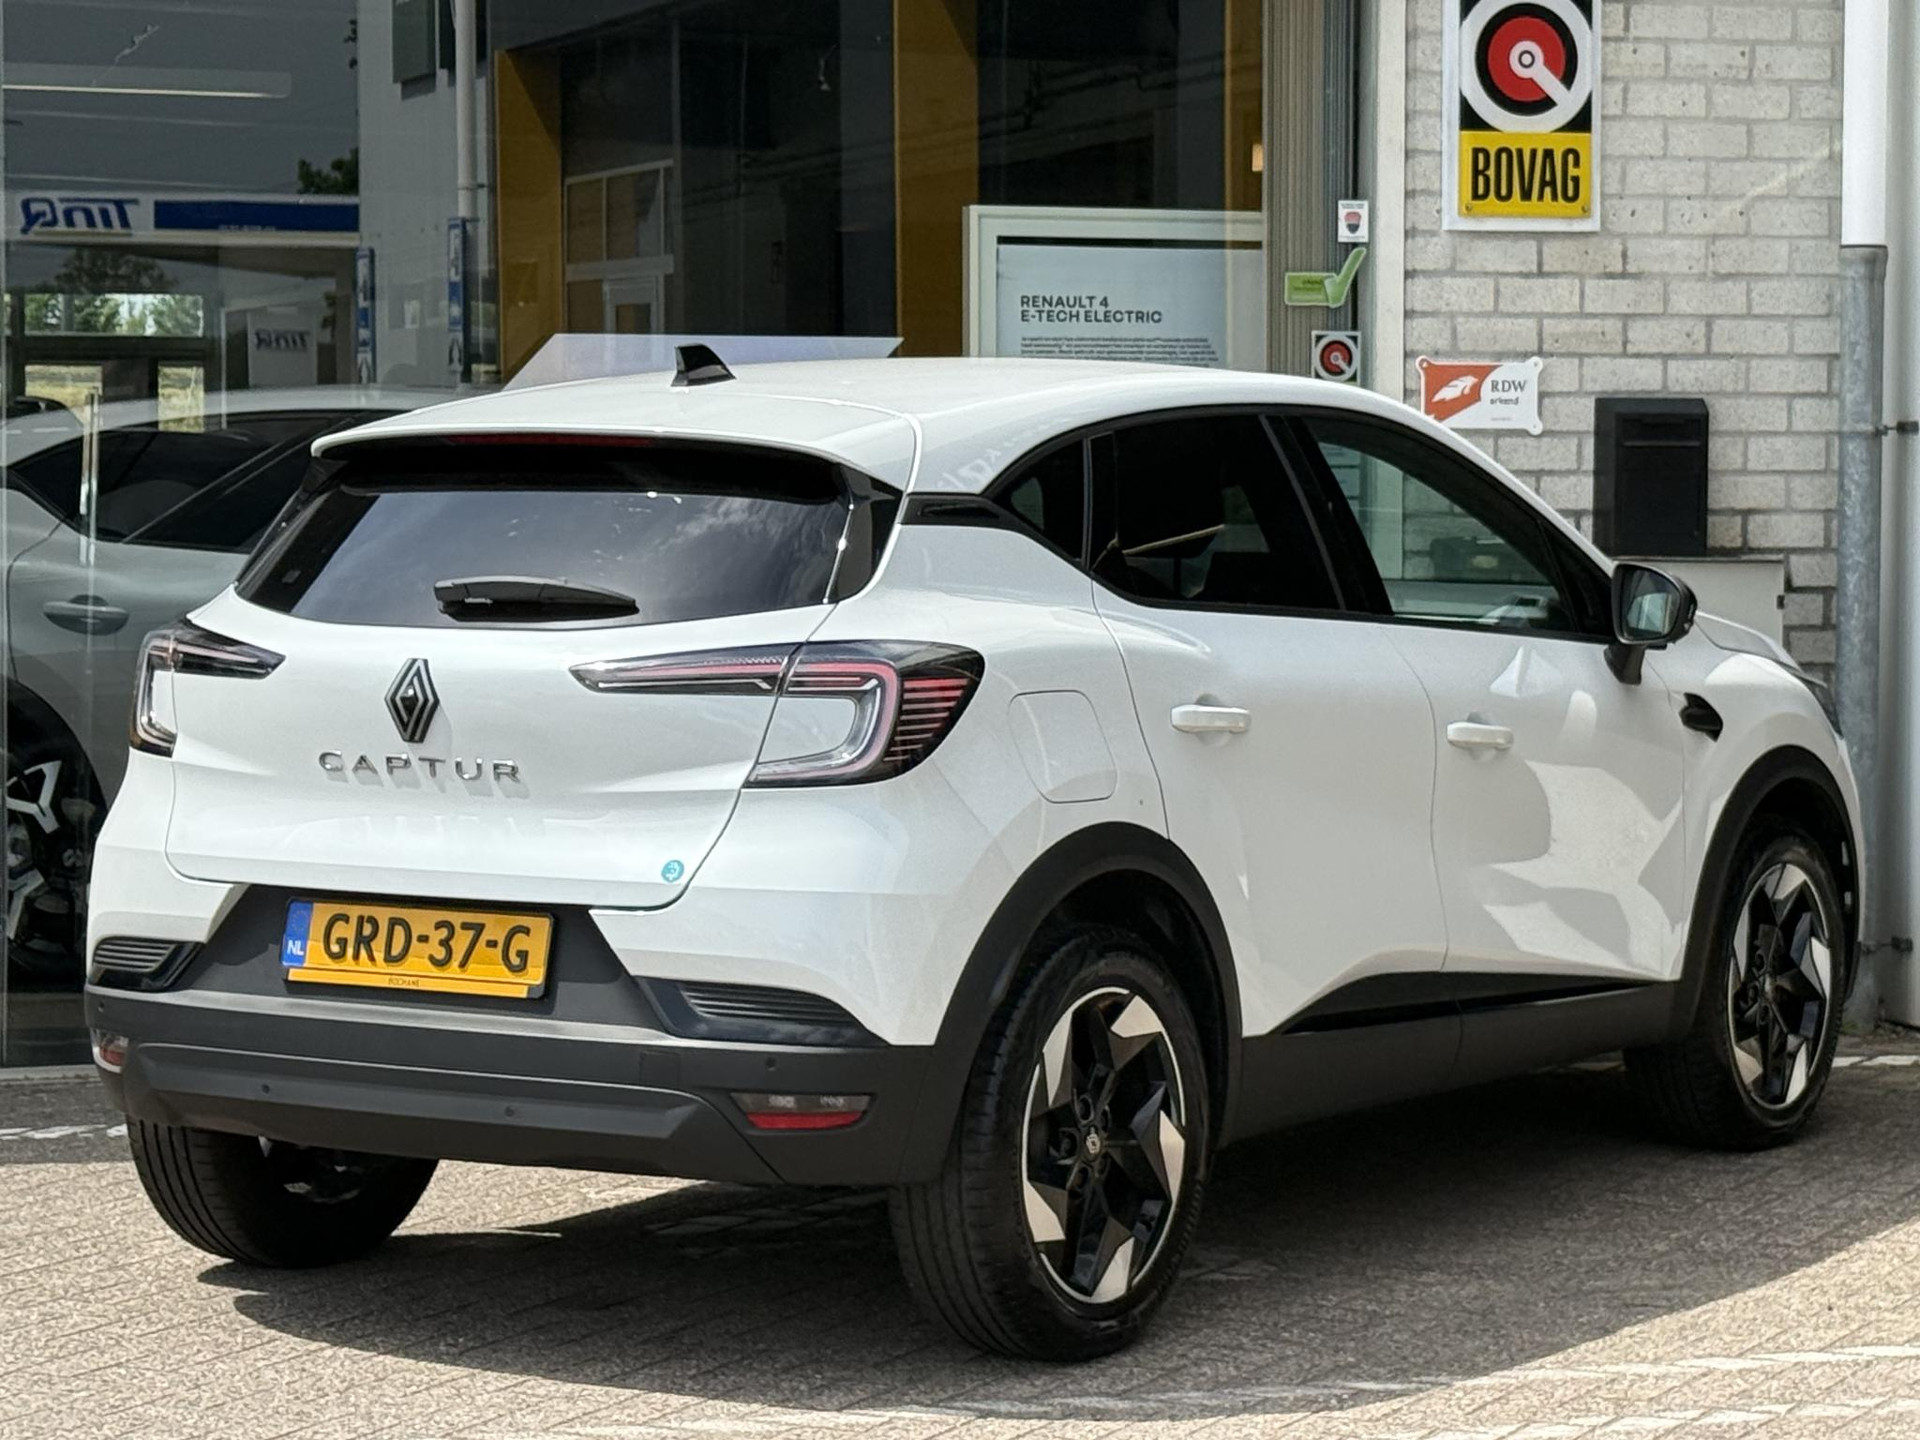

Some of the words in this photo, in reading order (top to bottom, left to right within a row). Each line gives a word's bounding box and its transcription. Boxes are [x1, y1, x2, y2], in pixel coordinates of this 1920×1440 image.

[1471, 147, 1580, 203] BOVAG
[1020, 295, 1096, 308] RENAULT
[1099, 296, 1109, 308] 4
[1020, 310, 1080, 323] E-TECH
[1084, 311, 1162, 323] ELECTRIC
[1490, 379, 1527, 393] RDW
[319, 751, 521, 782] CAPTUR
[286, 939, 304, 956] NL
[323, 913, 531, 973] GRD-37-G
